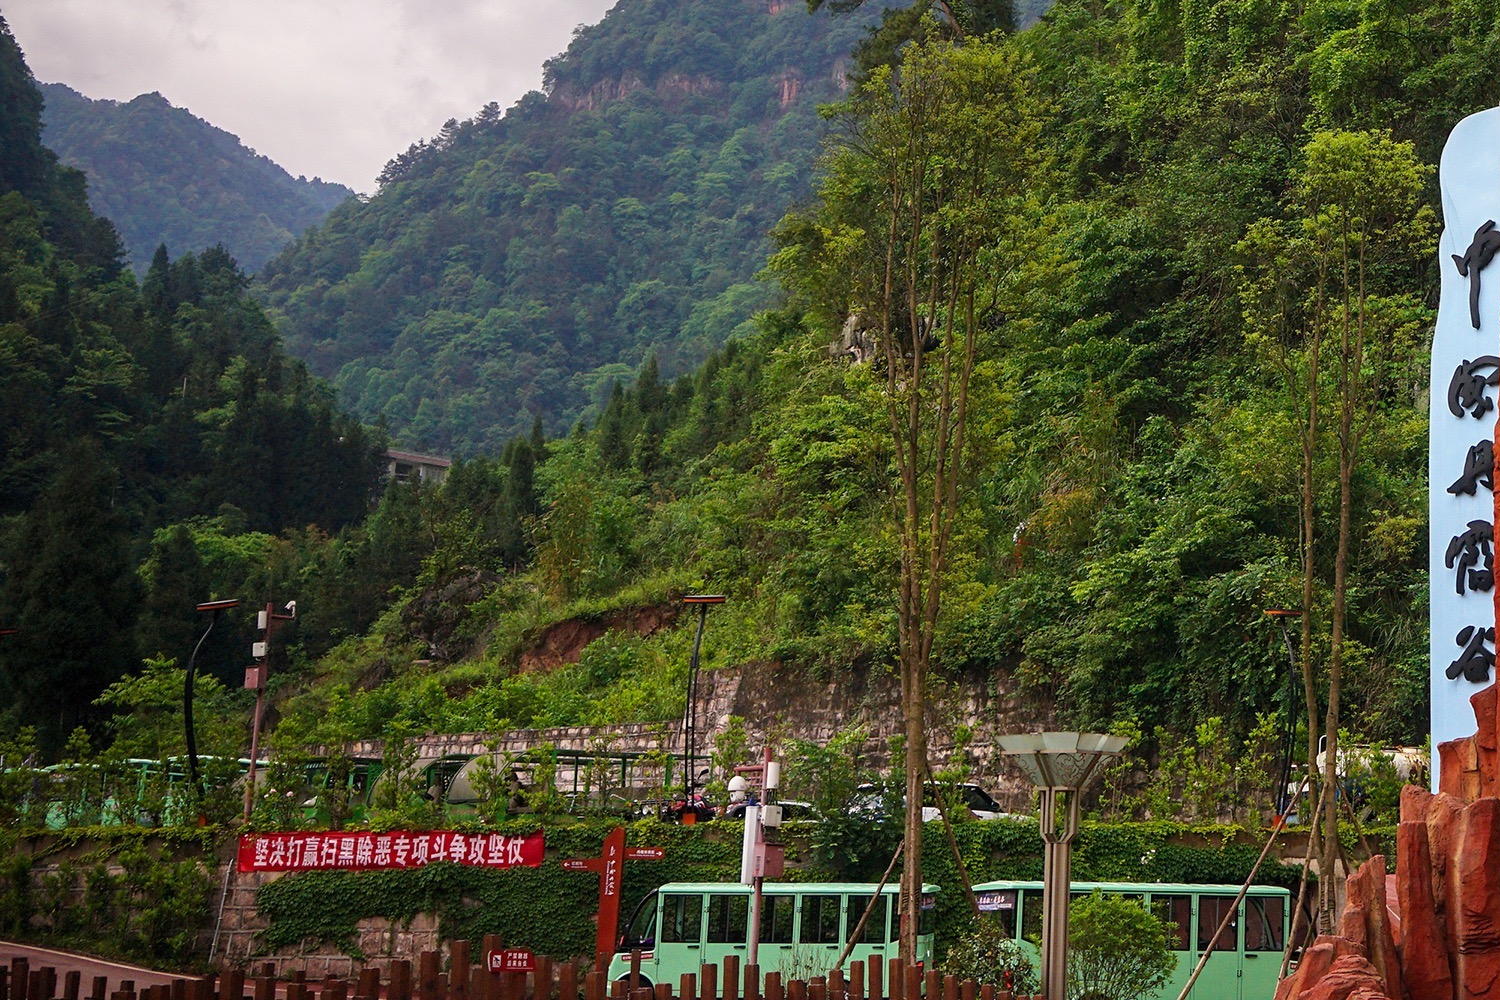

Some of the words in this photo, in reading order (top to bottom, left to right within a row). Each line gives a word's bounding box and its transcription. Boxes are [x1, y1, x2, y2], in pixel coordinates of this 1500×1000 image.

[254, 833, 525, 867] 坚决打赢扫黑除恶专项斗争攻坚仗
